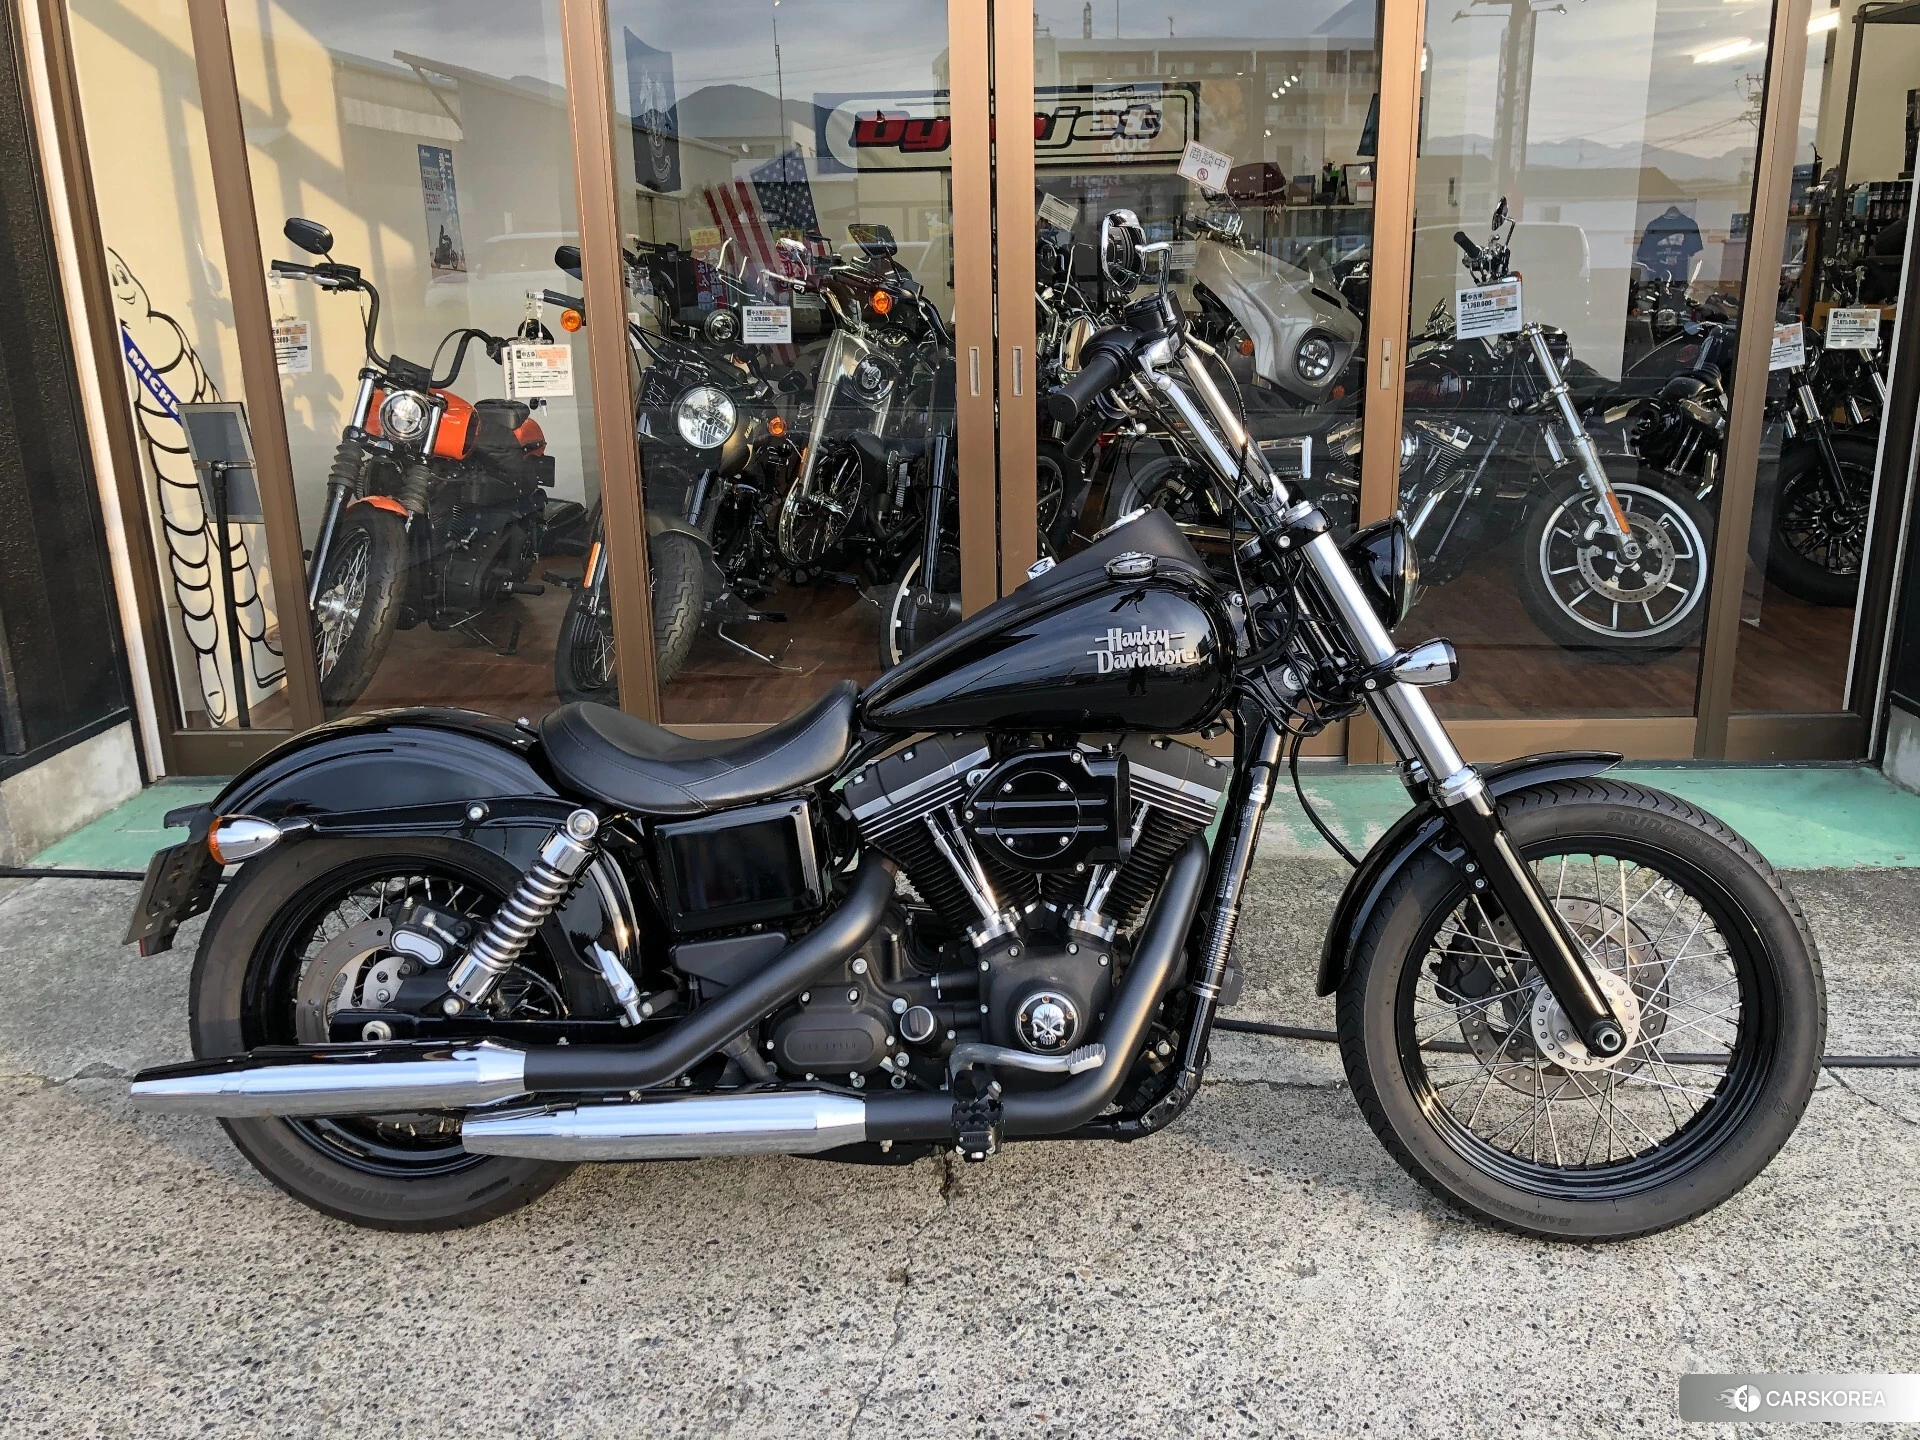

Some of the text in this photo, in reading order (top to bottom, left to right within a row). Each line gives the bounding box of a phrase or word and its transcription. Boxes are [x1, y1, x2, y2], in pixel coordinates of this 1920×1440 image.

[1190, 146, 1227, 170] 商談中
[1094, 625, 1187, 652] Harley
[1087, 645, 1200, 674] Davidson
[1606, 811, 1746, 878] BRIDGESTONE
